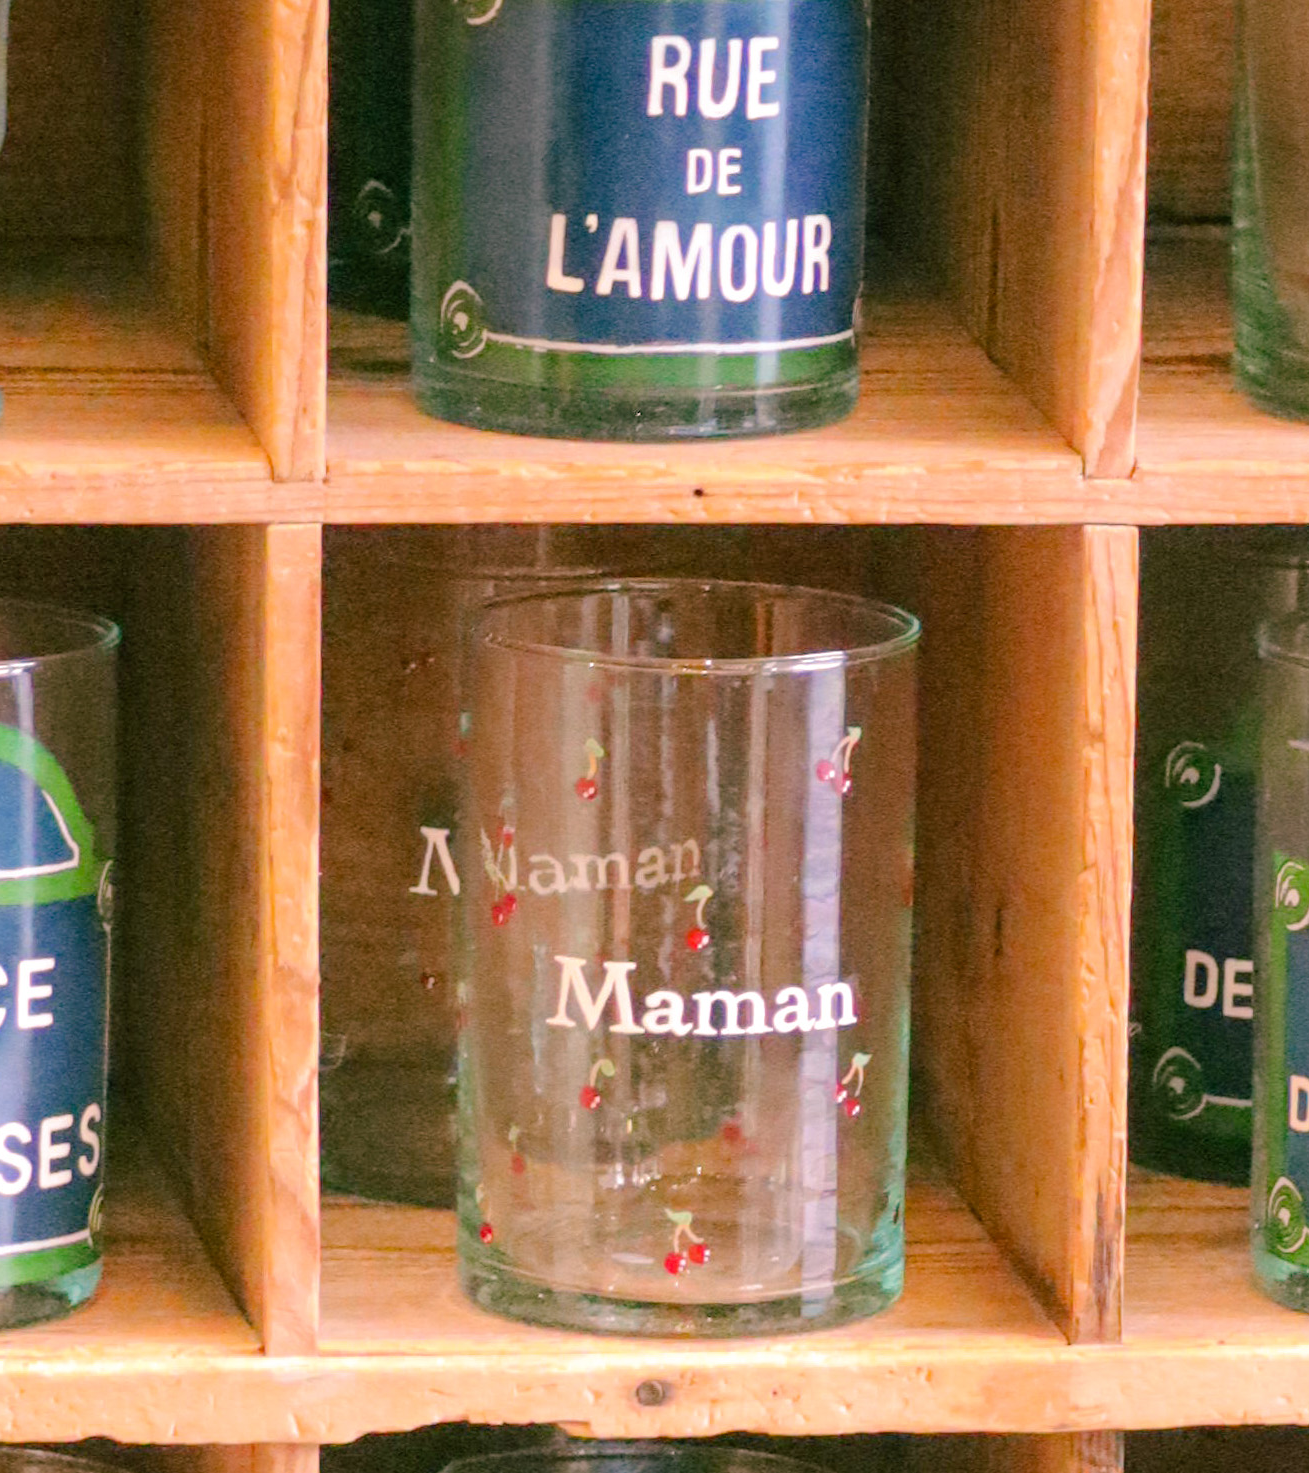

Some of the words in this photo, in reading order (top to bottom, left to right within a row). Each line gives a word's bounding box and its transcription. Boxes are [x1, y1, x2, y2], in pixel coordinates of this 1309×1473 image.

[646, 34, 781, 120] RUE
[686, 148, 742, 196] DE
[545, 211, 833, 304] L'AMOUR
[545, 954, 858, 1038] Maman
